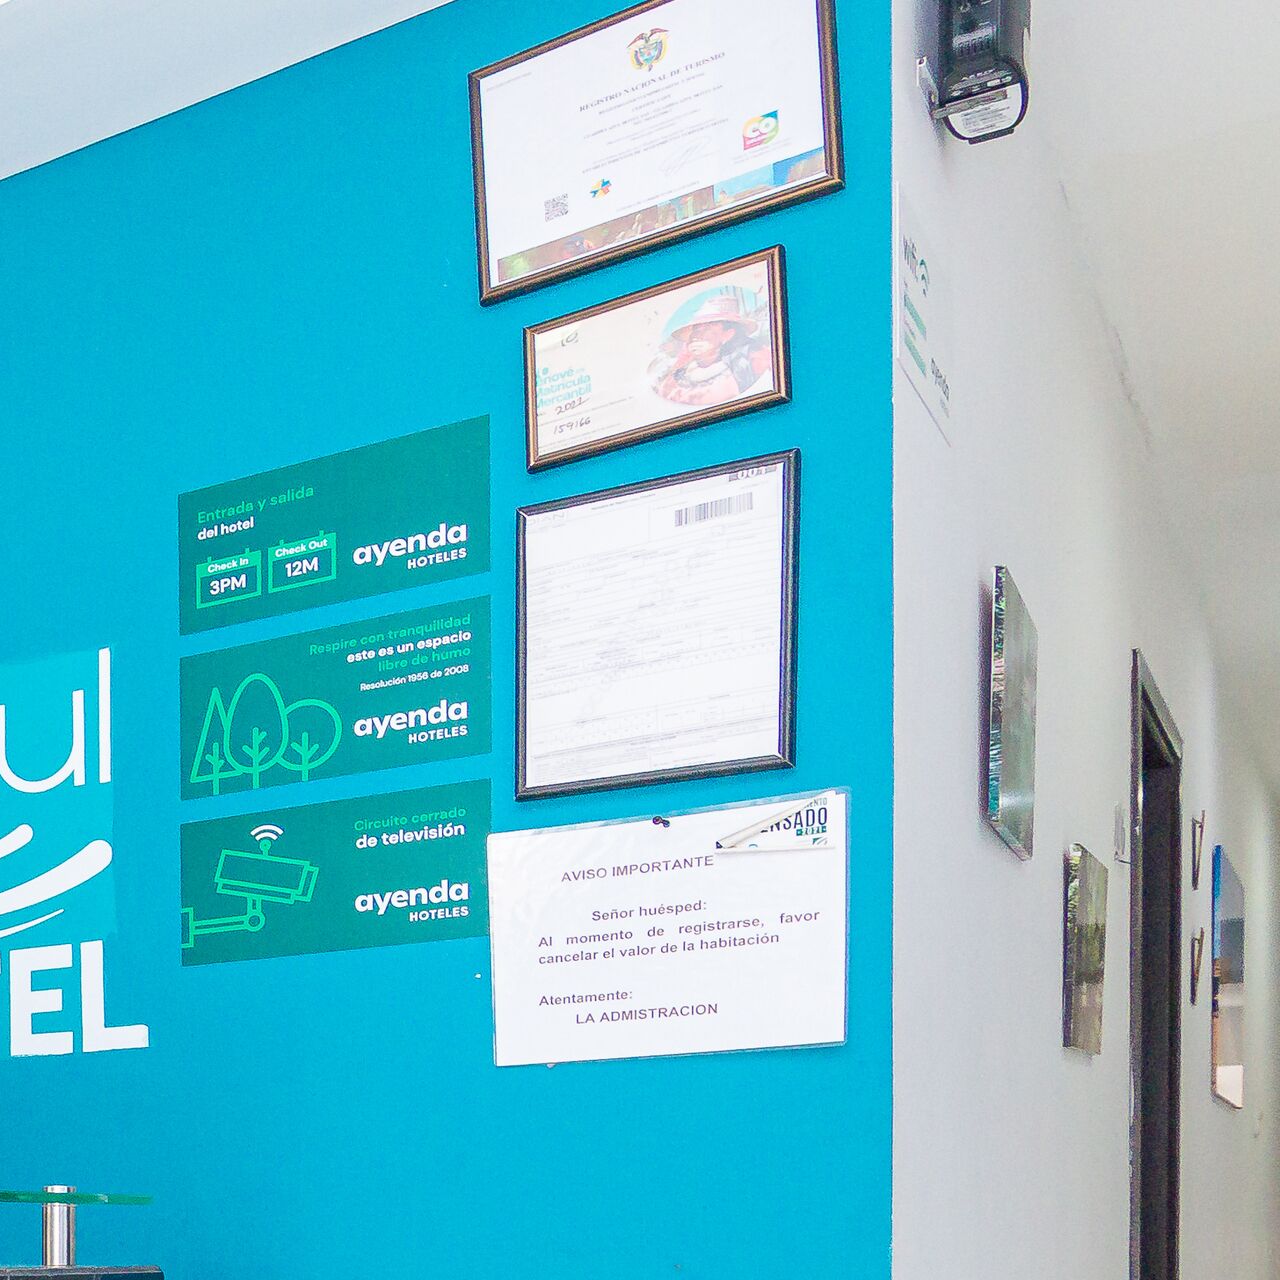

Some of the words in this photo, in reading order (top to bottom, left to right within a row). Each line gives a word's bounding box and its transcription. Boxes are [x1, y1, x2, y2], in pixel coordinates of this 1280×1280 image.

[579, 91, 622, 112] REGISTRO
[624, 74, 667, 94] NACIONAL
[685, 51, 726, 72] TURISMO
[197, 499, 254, 524] Entrada
[257, 497, 267, 512] y
[269, 486, 315, 506] salida
[197, 523, 218, 540] del
[220, 516, 254, 535] hotel
[275, 543, 306, 558] Check
[308, 538, 328, 551] Out
[352, 523, 468, 566] ayenda
[207, 561, 238, 573] Check
[239, 557, 249, 567] In
[284, 557, 319, 578] 12M
[407, 548, 468, 570] HOTELES
[209, 574, 247, 596] 3PM
[309, 638, 357, 656] Respire
[360, 633, 385, 645] con
[387, 614, 471, 639] tranquilidad
[346, 650, 376, 664] este
[378, 646, 395, 657] es
[397, 642, 415, 654] un
[417, 630, 472, 650] espacio
[378, 656, 408, 672] libre
[411, 652, 428, 665] de
[432, 646, 471, 662] humo
[360, 675, 407, 691] Resolución
[407, 672, 429, 683] 1956
[430, 669, 442, 679] de
[444, 664, 469, 676] 2008
[353, 699, 468, 739] ayenda
[408, 725, 468, 744] HOTELES
[354, 815, 408, 832] Circuito
[411, 806, 467, 824] cerrado
[355, 834, 378, 849] de
[381, 823, 466, 847] televisión
[561, 867, 608, 882] AVISO
[612, 855, 715, 878] IMPORTANTE
[354, 879, 470, 916] ayenda
[409, 905, 470, 923] HOTELES
[591, 908, 635, 922] Señor
[639, 900, 708, 919] huésped:
[538, 937, 553, 947] Al
[566, 930, 634, 946] momento
[647, 926, 665, 938] de
[678, 916, 765, 935] registrarse,
[780, 911, 820, 925] favor
[538, 950, 599, 965] cancelar
[602, 947, 615, 959] el
[619, 945, 657, 958] valor
[660, 942, 678, 954] de
[683, 941, 695, 952] la
[700, 932, 780, 950] habitación
[539, 990, 633, 1006] Atentamente:
[576, 1013, 595, 1024] LA
[600, 1003, 718, 1022] ADMISTRACION
